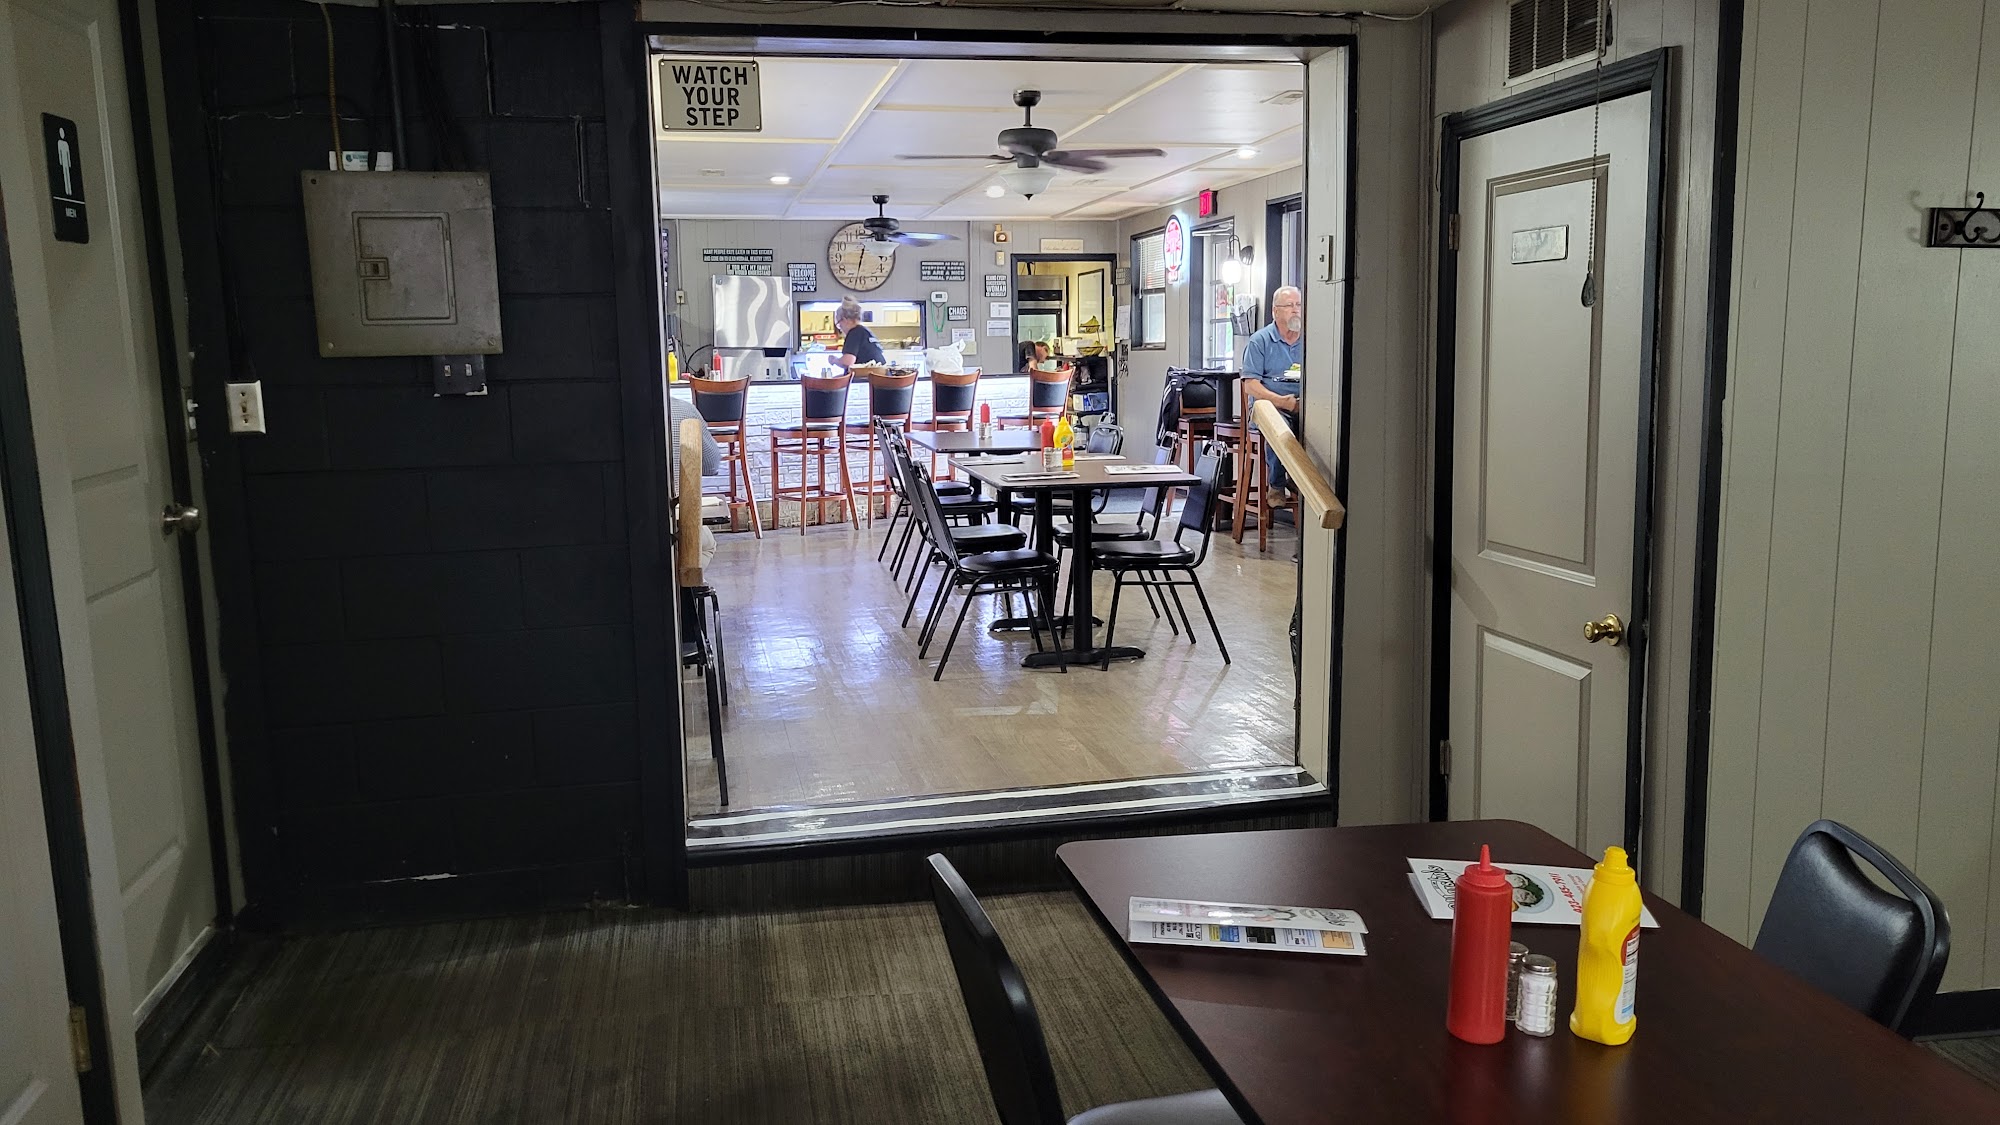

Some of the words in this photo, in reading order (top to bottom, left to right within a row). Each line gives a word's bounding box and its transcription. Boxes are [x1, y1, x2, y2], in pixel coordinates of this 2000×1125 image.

[672, 65, 748, 86] WATCH
[682, 86, 740, 106] YOUR
[686, 107, 740, 126] STEP
[65, 207, 77, 218] MEN
[836, 241, 846, 251] 10
[835, 253, 842, 263] 9
[788, 269, 816, 277] WELCOME
[839, 264, 846, 275] 8
[876, 263, 885, 273] 4
[859, 276, 866, 285] 6
[948, 307, 967, 316] CHAOS
